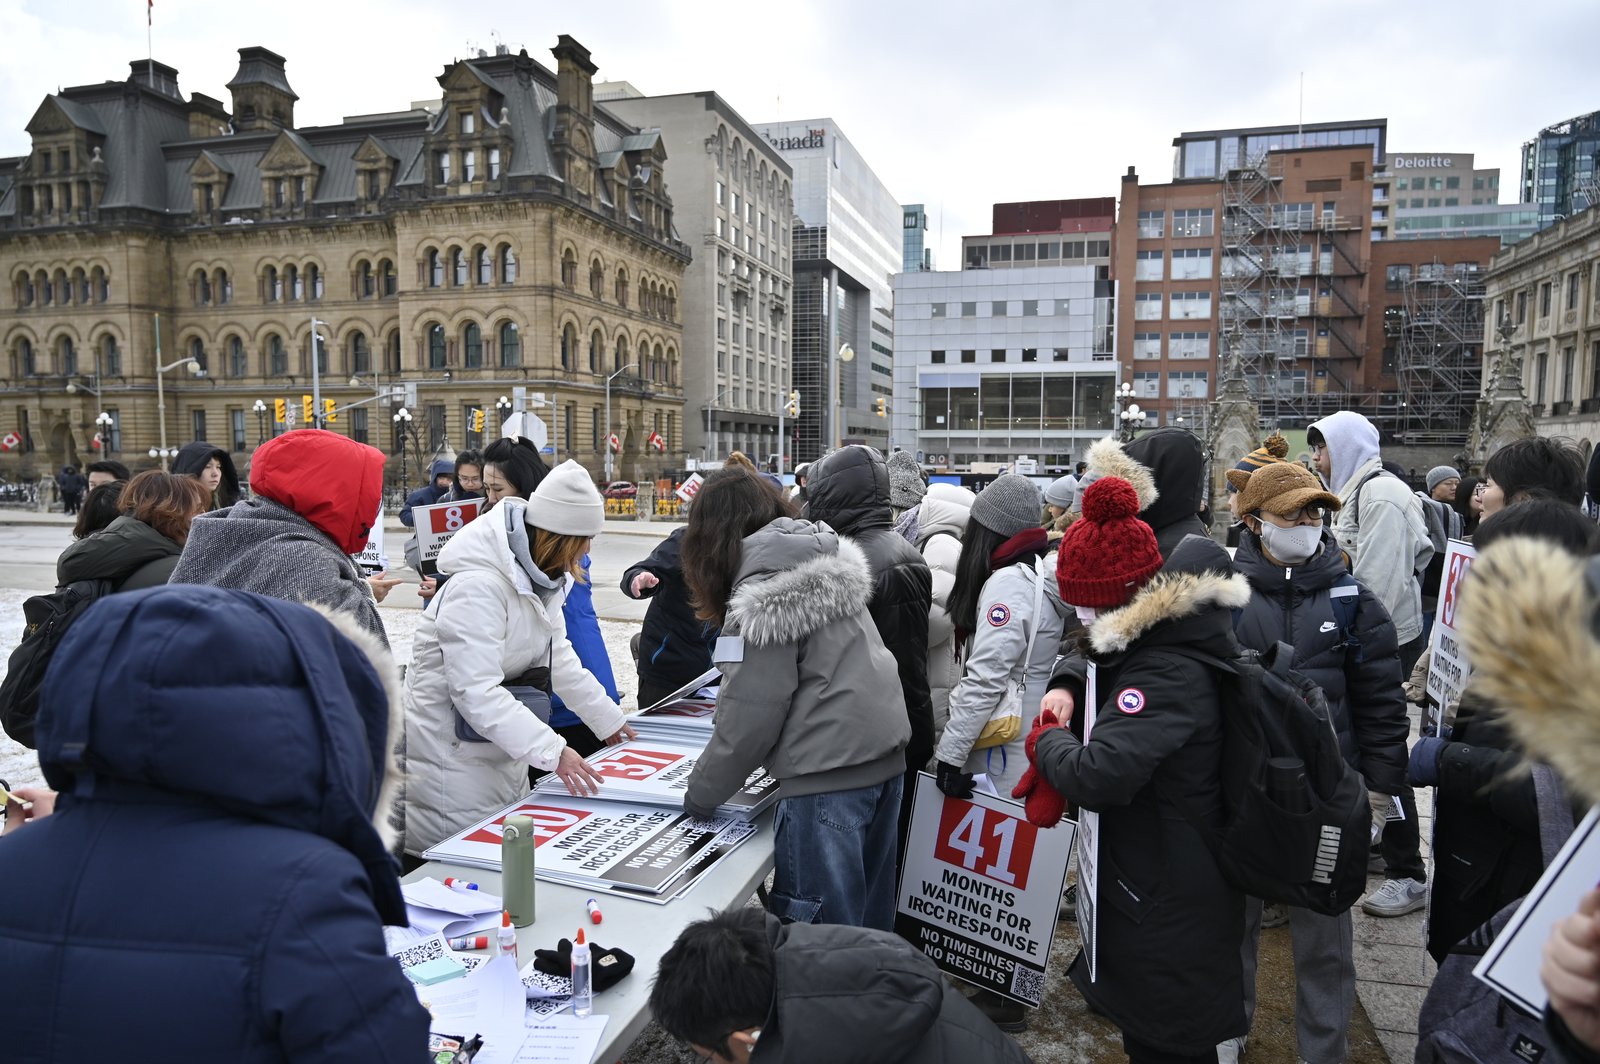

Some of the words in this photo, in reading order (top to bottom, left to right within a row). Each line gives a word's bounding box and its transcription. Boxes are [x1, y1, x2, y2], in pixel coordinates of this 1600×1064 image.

[1394, 156, 1452, 169] Deloitte
[929, 454, 946, 464] 90
[445, 506, 464, 531] 8
[366, 542, 376, 550] OR
[1434, 651, 1451, 678] WAITING
[592, 752, 674, 776] 37
[553, 817, 611, 849] MONTHS
[562, 828, 621, 860] WAITING
[612, 813, 645, 828] FOR
[579, 851, 617, 871] IRCC
[606, 811, 672, 851] RESPONSE
[948, 800, 1016, 884] 41
[625, 856, 649, 868] NO
[649, 857, 673, 869] NO
[1312, 825, 1341, 884] PUMA
[942, 869, 1016, 907] MONTHS
[922, 881, 992, 919] WAITING
[996, 909, 1031, 934] FOR
[908, 895, 945, 920] IRCC
[946, 909, 1039, 956] RESPONSE
[920, 926, 939, 943] NO
[943, 935, 1015, 972] TIMELINES
[924, 944, 943, 959] NO
[946, 952, 1006, 984] RESULTS
